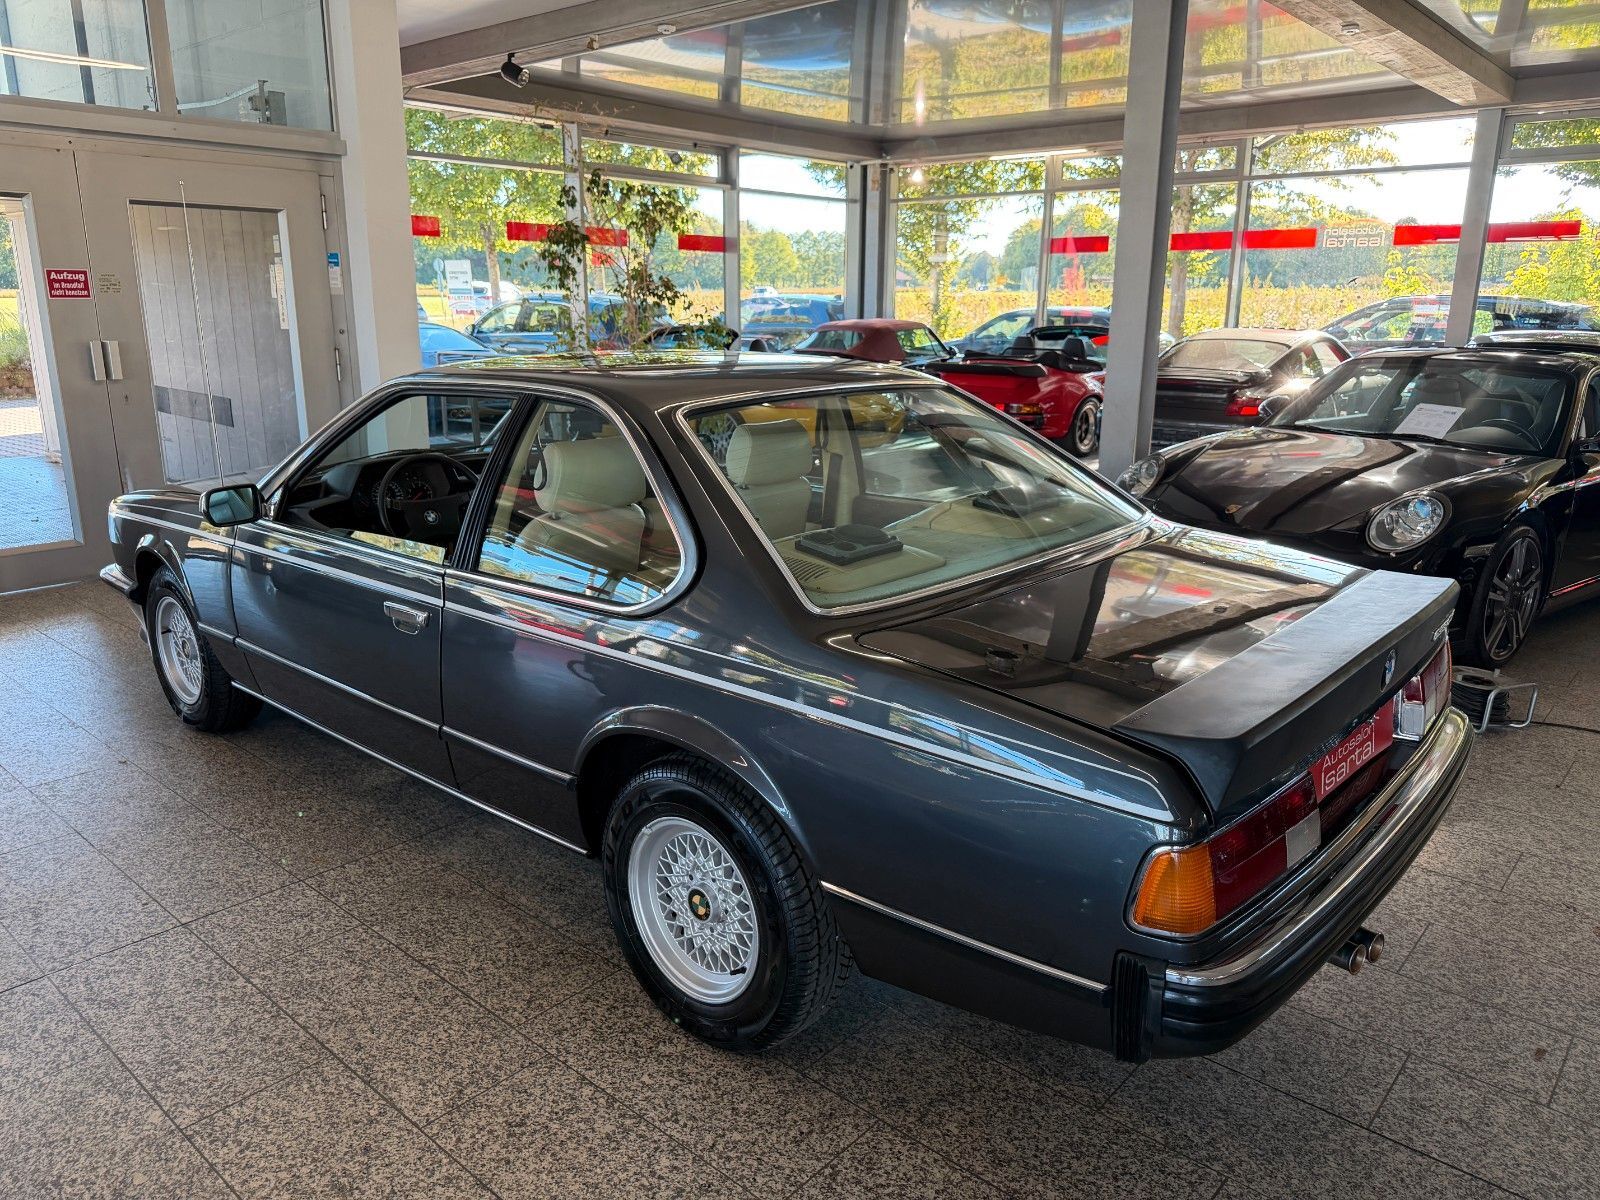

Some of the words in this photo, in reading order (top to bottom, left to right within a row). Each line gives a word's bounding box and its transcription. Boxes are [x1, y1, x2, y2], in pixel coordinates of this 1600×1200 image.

[50, 271, 85, 281] Aufzug
[1321, 730, 1375, 795] Isartal
[1322, 721, 1375, 771] Autosalon
